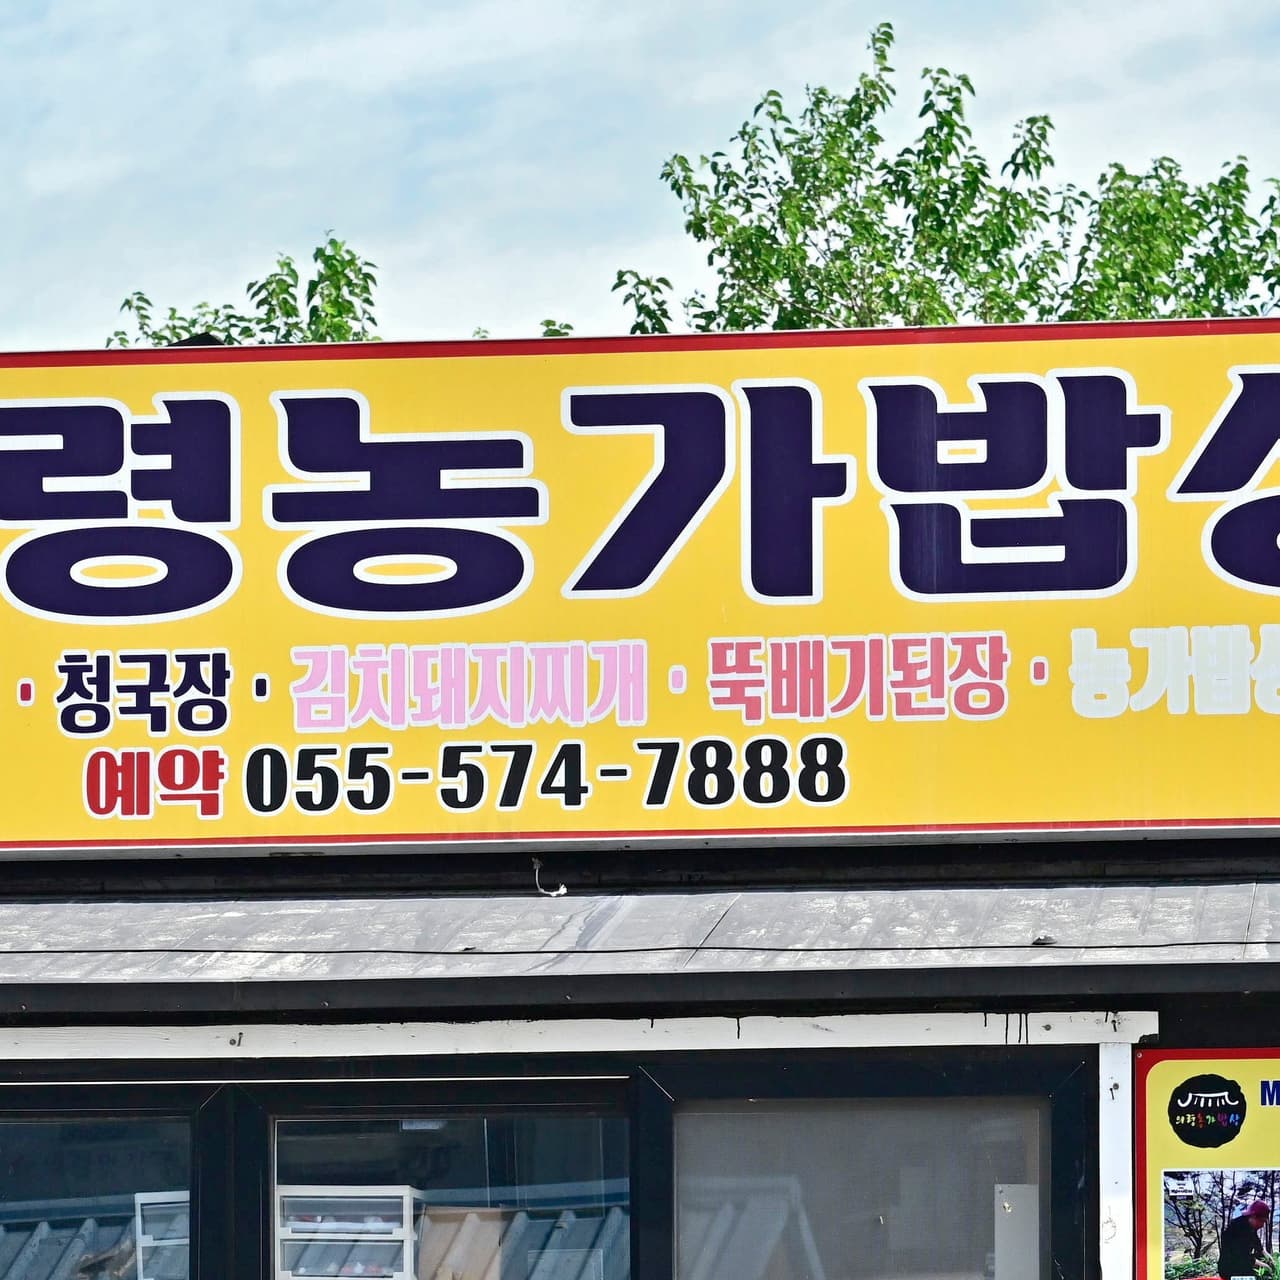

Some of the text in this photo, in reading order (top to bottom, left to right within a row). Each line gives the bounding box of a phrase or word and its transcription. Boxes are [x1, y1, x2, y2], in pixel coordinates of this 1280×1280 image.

[56, 649, 232, 736] 청국장
[289, 639, 649, 732] 김치돼지찌개
[708, 632, 1010, 722] 뚝배기된장
[83, 733, 851, 819] 예약 055-574-7888
